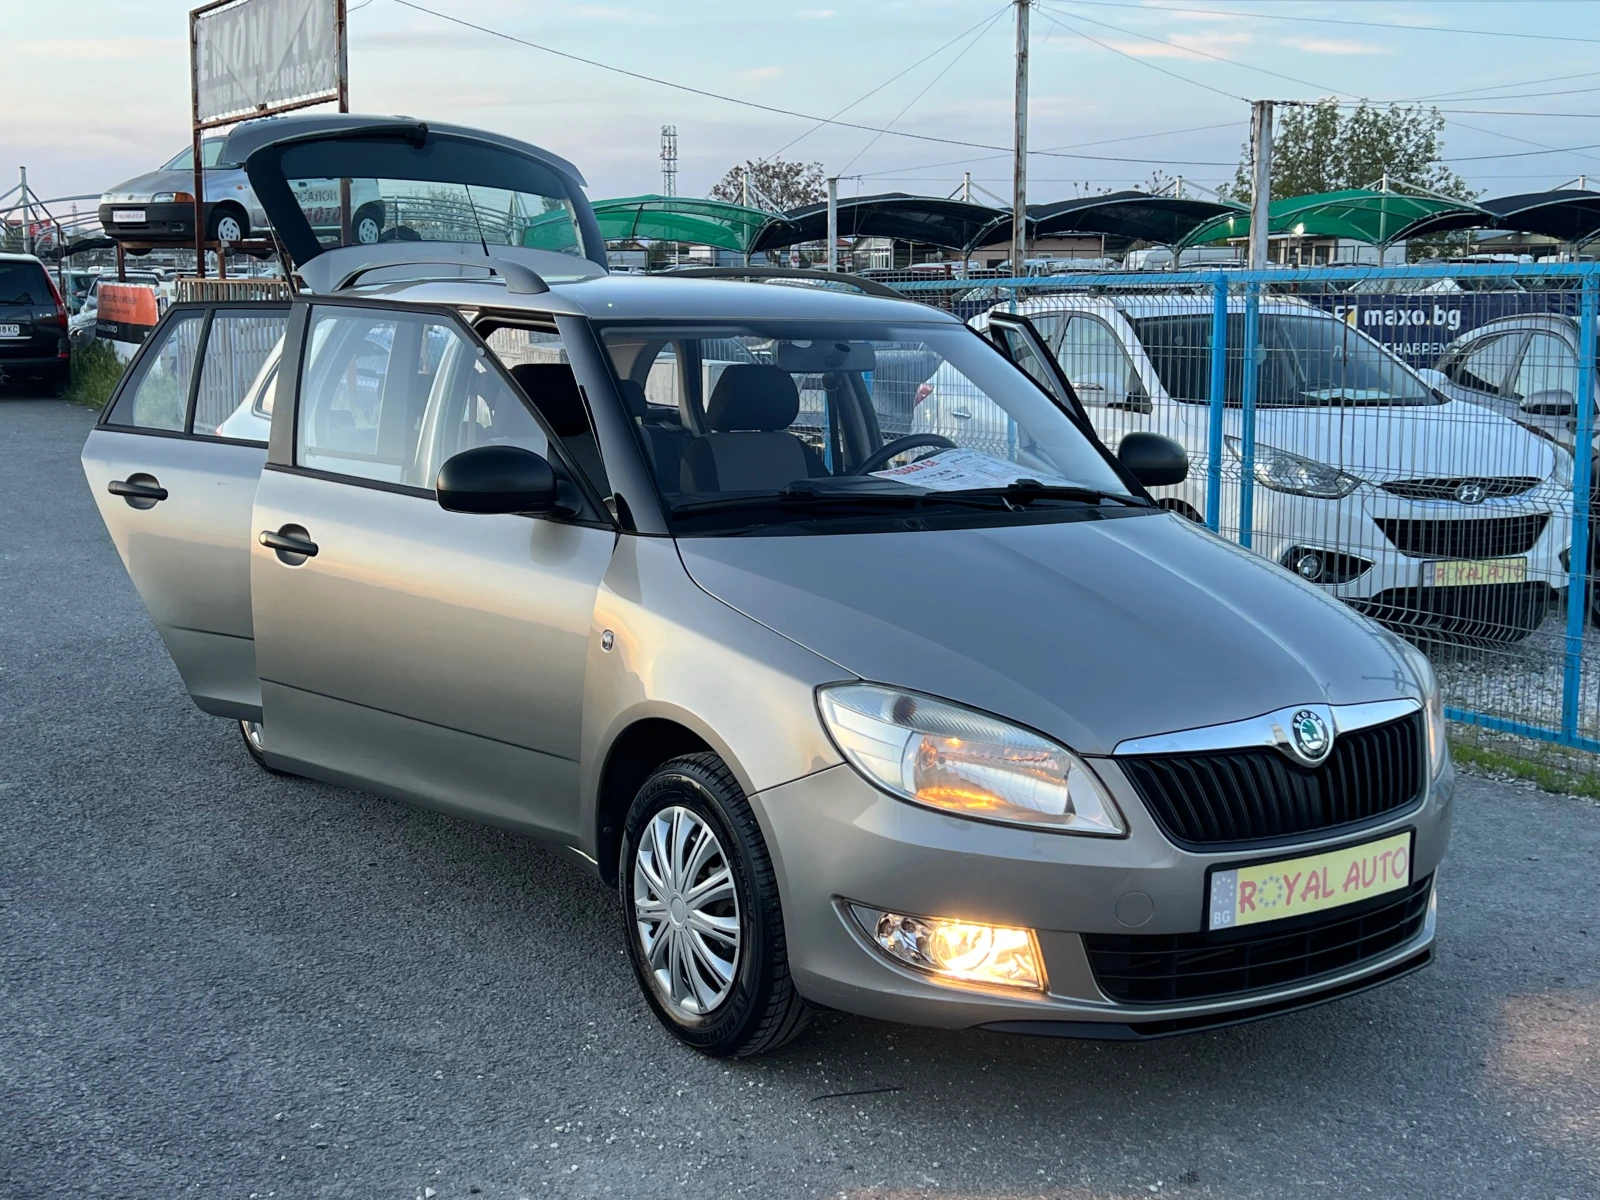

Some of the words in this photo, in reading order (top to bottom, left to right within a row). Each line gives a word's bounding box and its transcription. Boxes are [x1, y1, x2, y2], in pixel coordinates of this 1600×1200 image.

[1363, 305, 1461, 331] maxo.bg
[0, 325, 18, 334] 8KC
[1436, 566, 1483, 582] RYAL
[1239, 866, 1335, 914] ROYAL
[1342, 846, 1408, 893] AUTO
[1213, 910, 1231, 925] BG
